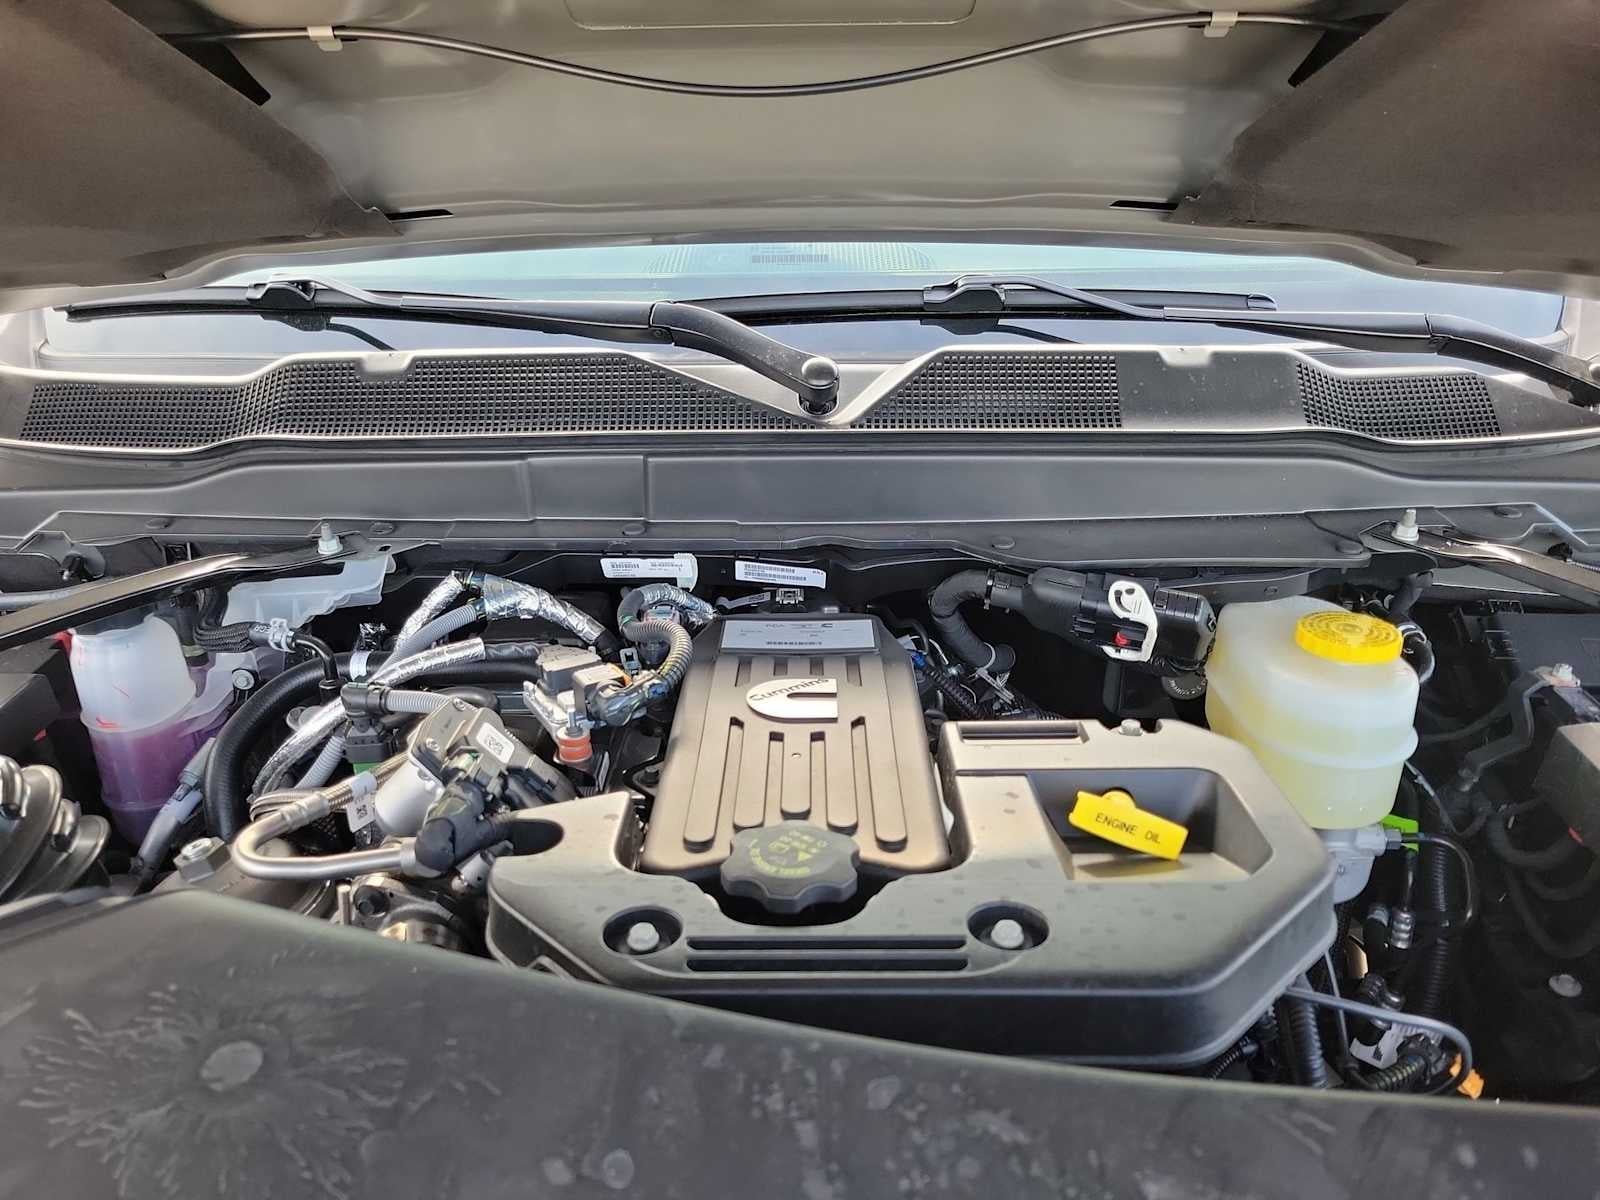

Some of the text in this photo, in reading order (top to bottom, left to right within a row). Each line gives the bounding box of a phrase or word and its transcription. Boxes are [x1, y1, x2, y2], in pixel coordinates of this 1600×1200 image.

[749, 678, 829, 701] Cummins
[1095, 812, 1161, 844] ENGINE OIL
